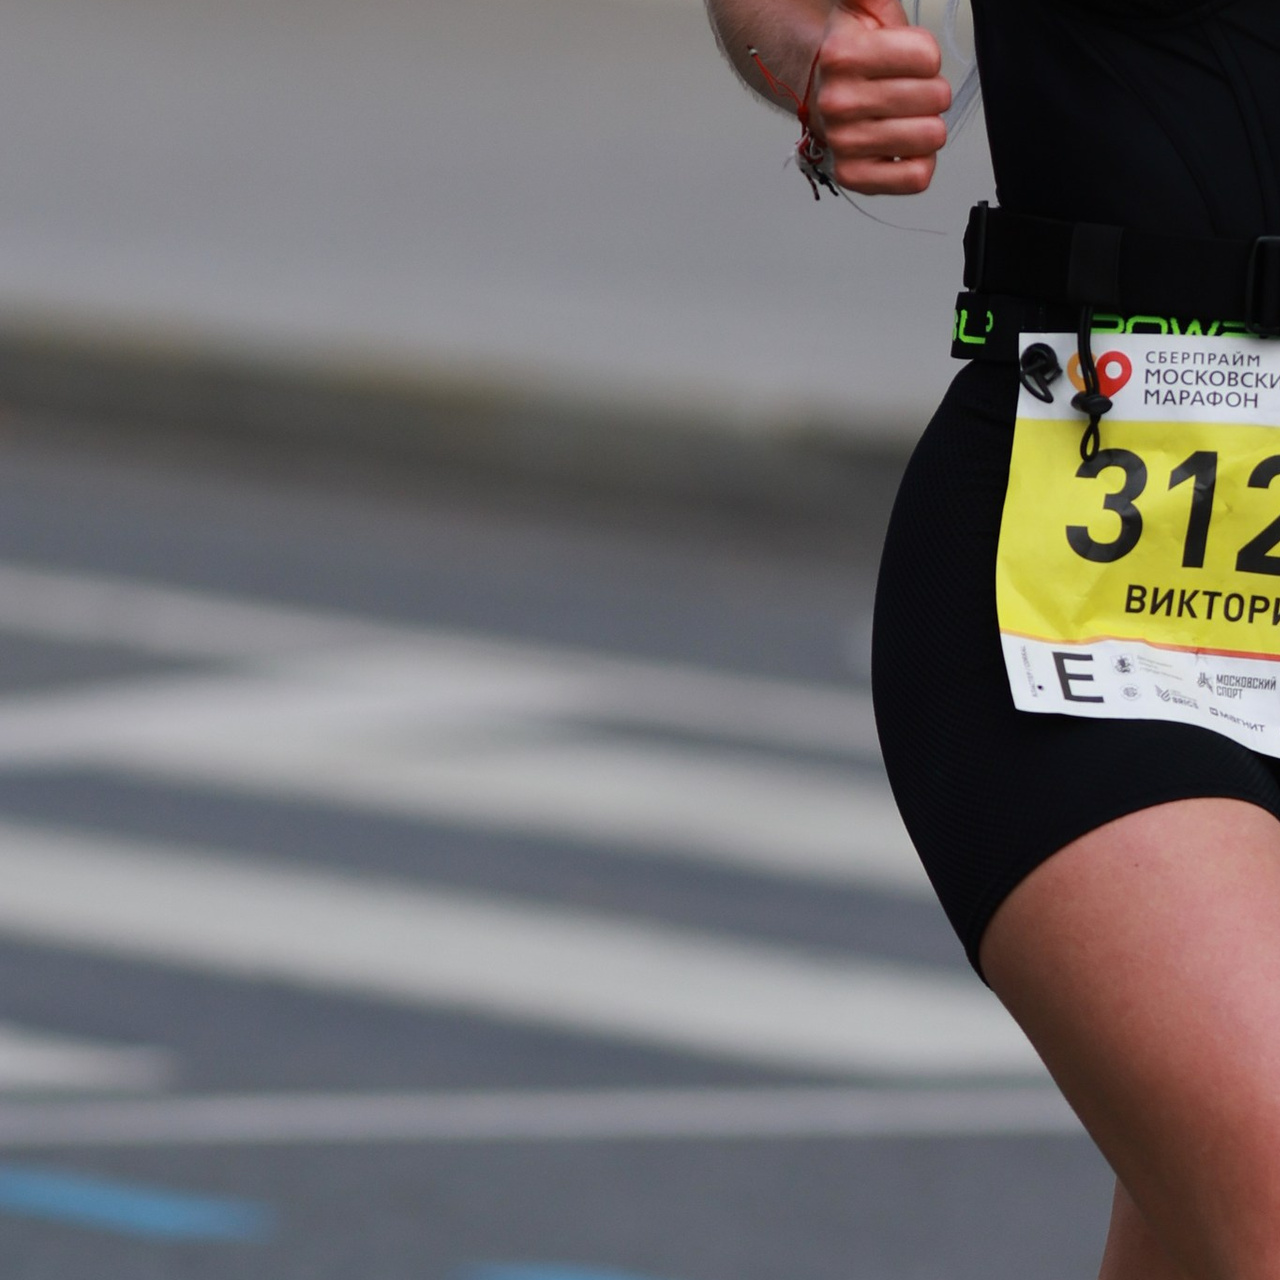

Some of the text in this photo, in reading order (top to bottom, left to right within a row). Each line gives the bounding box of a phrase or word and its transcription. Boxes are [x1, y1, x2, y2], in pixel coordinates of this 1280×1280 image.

[1145, 350, 1261, 368] СБЕРПРАЙМ
[1143, 389, 1259, 409] МАРАФОН
[1052, 651, 1104, 704] E
[1216, 674, 1277, 691] МОСКОВСКИЙ
[1216, 686, 1243, 700] СПОРТ
